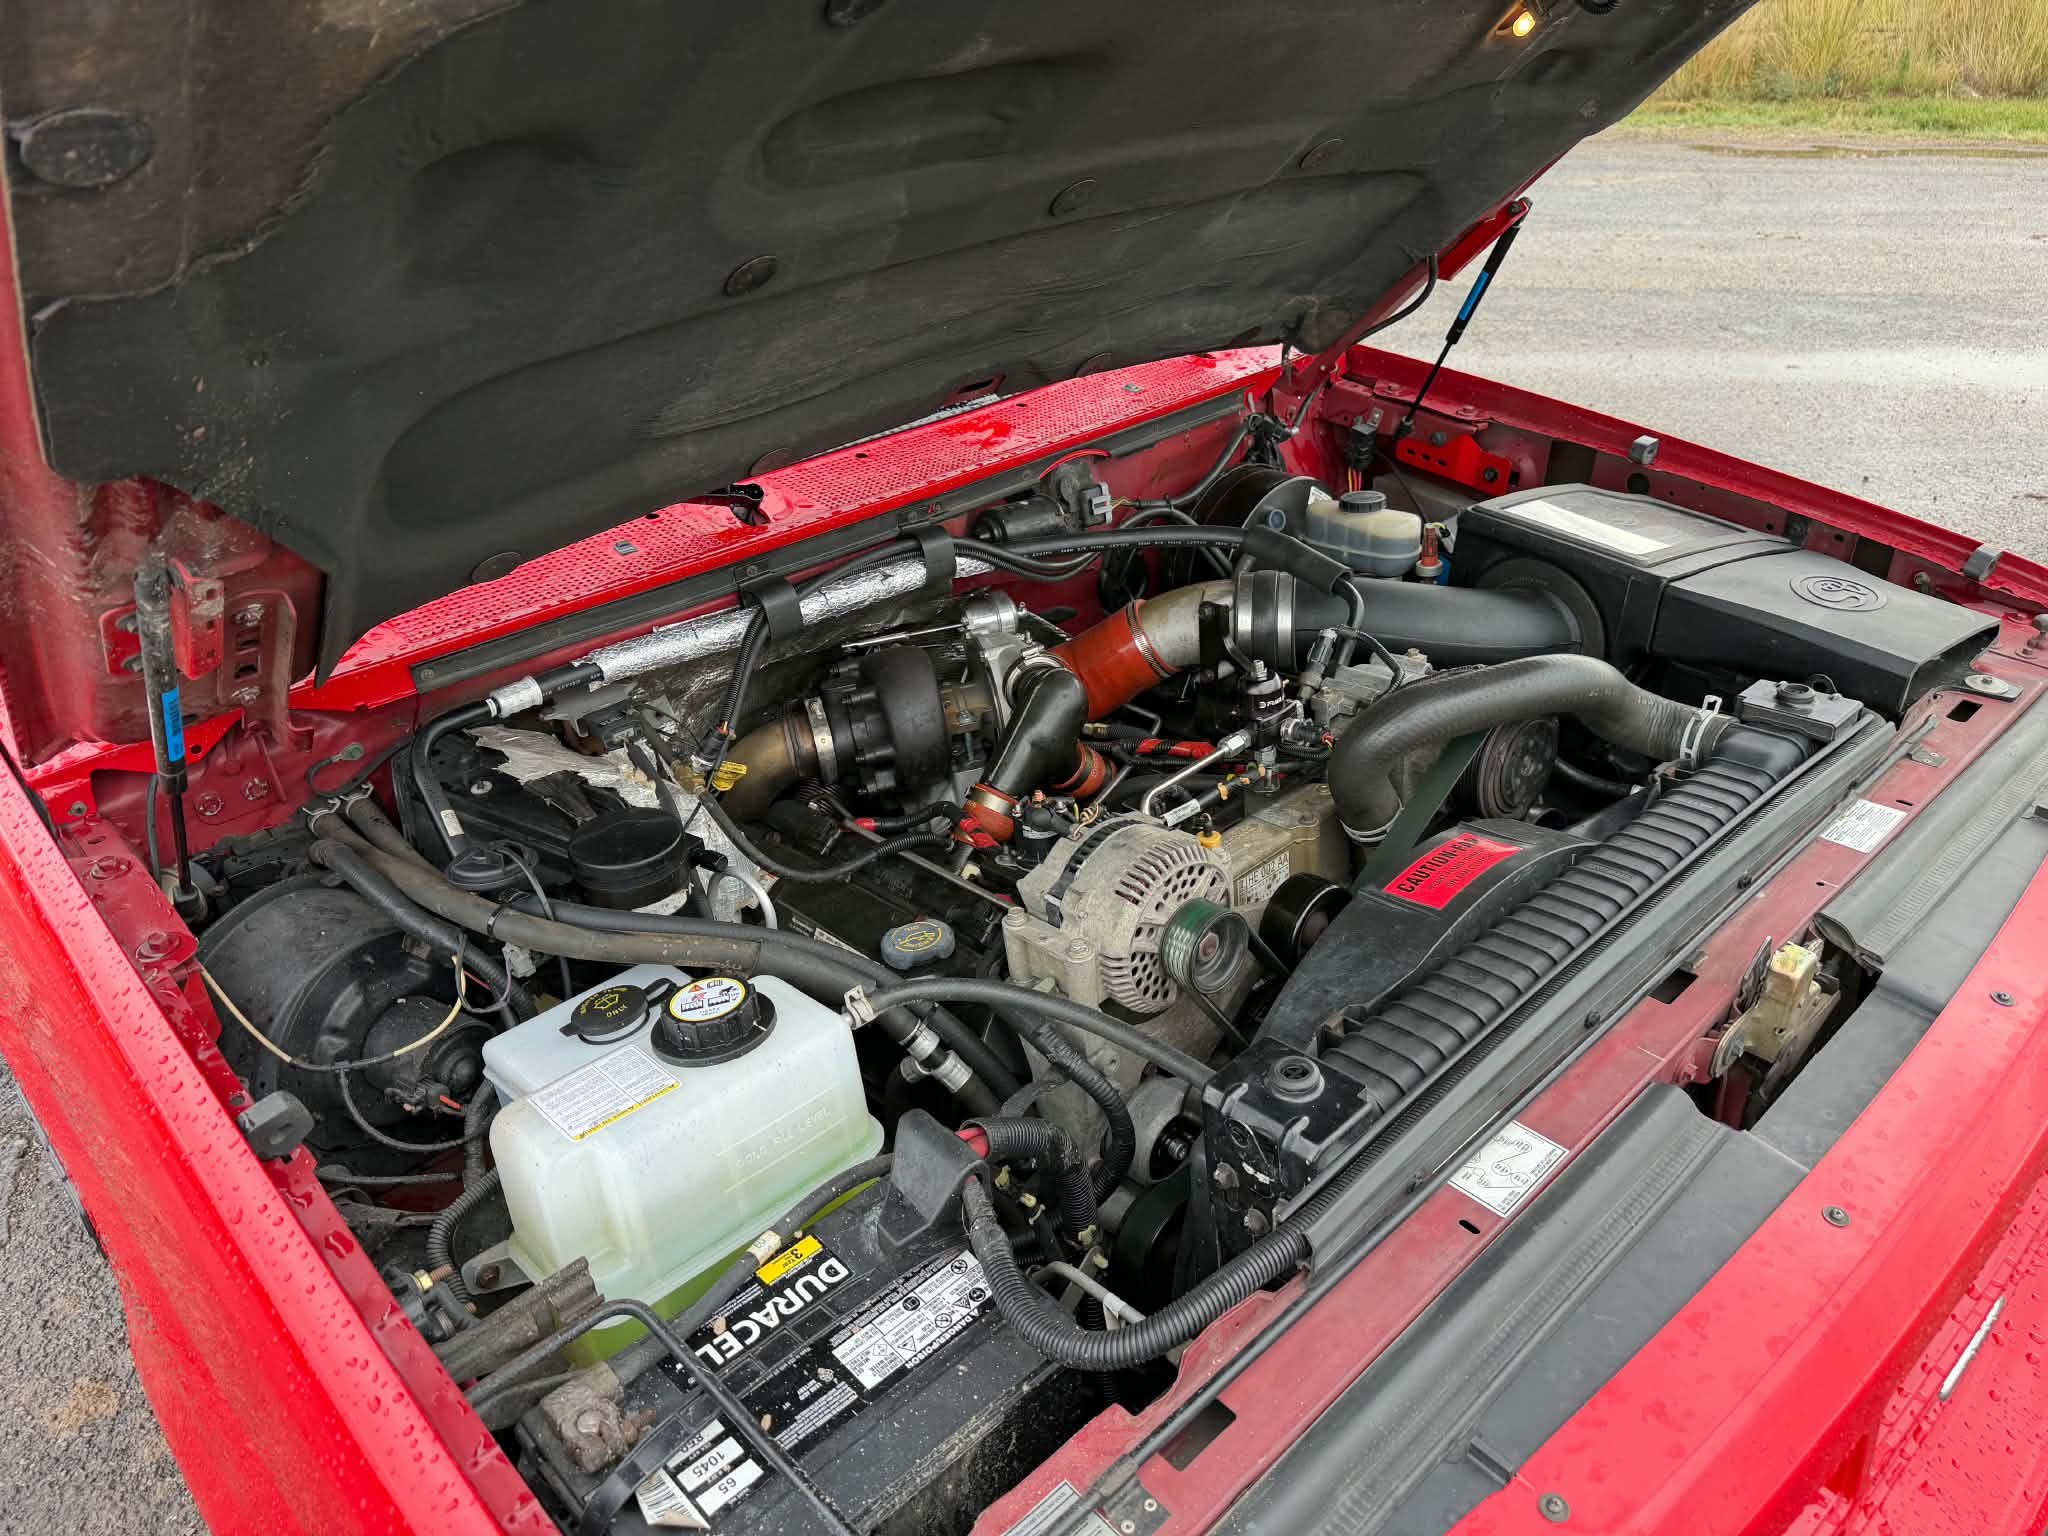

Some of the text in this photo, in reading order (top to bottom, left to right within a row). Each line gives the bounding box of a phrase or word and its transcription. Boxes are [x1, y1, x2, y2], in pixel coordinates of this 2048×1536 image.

[1394, 836, 1480, 893] CAUTION-FAN
[788, 1246, 803, 1262] 3
[676, 1257, 849, 1372] DURACEL
[904, 1313, 972, 1369] DANGER/POISON
[691, 1449, 725, 1478] 1045
[716, 1475, 737, 1494] 65
